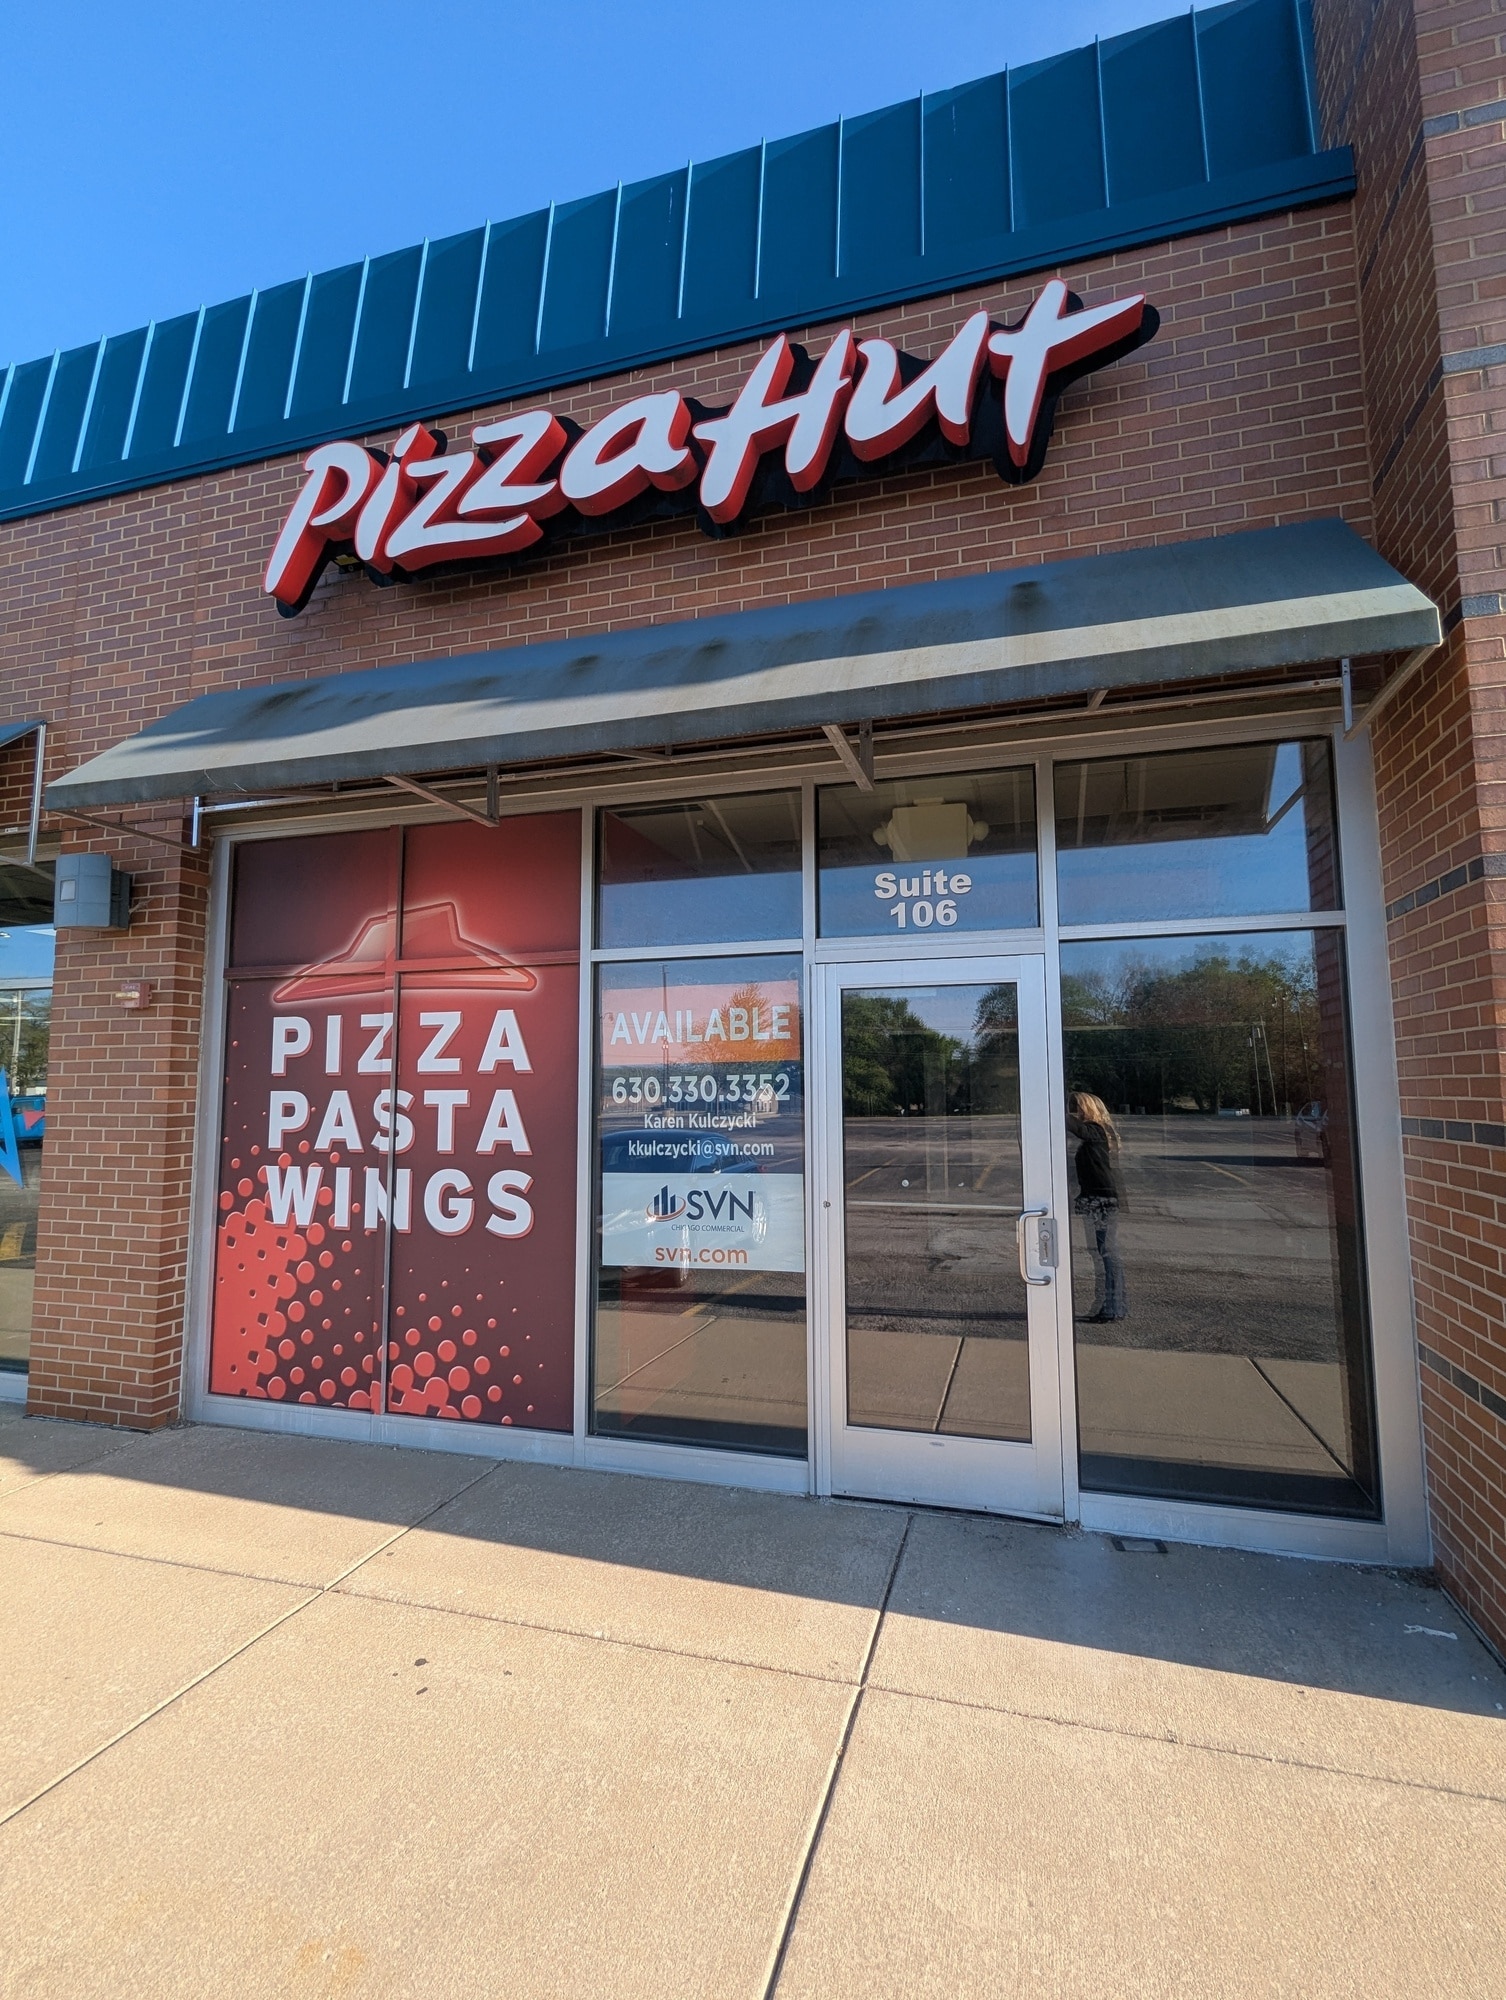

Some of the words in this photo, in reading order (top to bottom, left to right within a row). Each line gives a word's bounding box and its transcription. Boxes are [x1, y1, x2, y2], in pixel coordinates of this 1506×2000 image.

[264, 389, 697, 606] Pizza
[692, 278, 1147, 522] Hut
[874, 869, 972, 899] Suite
[890, 899, 958, 928] 106
[610, 1005, 791, 1045] AVAILABLE
[271, 1009, 534, 1076] PIZZA
[612, 1073, 790, 1103] 630.330.3352
[268, 1089, 533, 1155] PASTA
[644, 1113, 684, 1129] Karen
[688, 1112, 756, 1131] Kulczycki
[628, 1140, 775, 1159] kkulczycki@svn.com
[265, 1165, 534, 1239] WINGS
[686, 1190, 754, 1221] SVN
[701, 1224, 745, 1233] COMMERCIAL
[655, 1247, 748, 1264] svn.com
